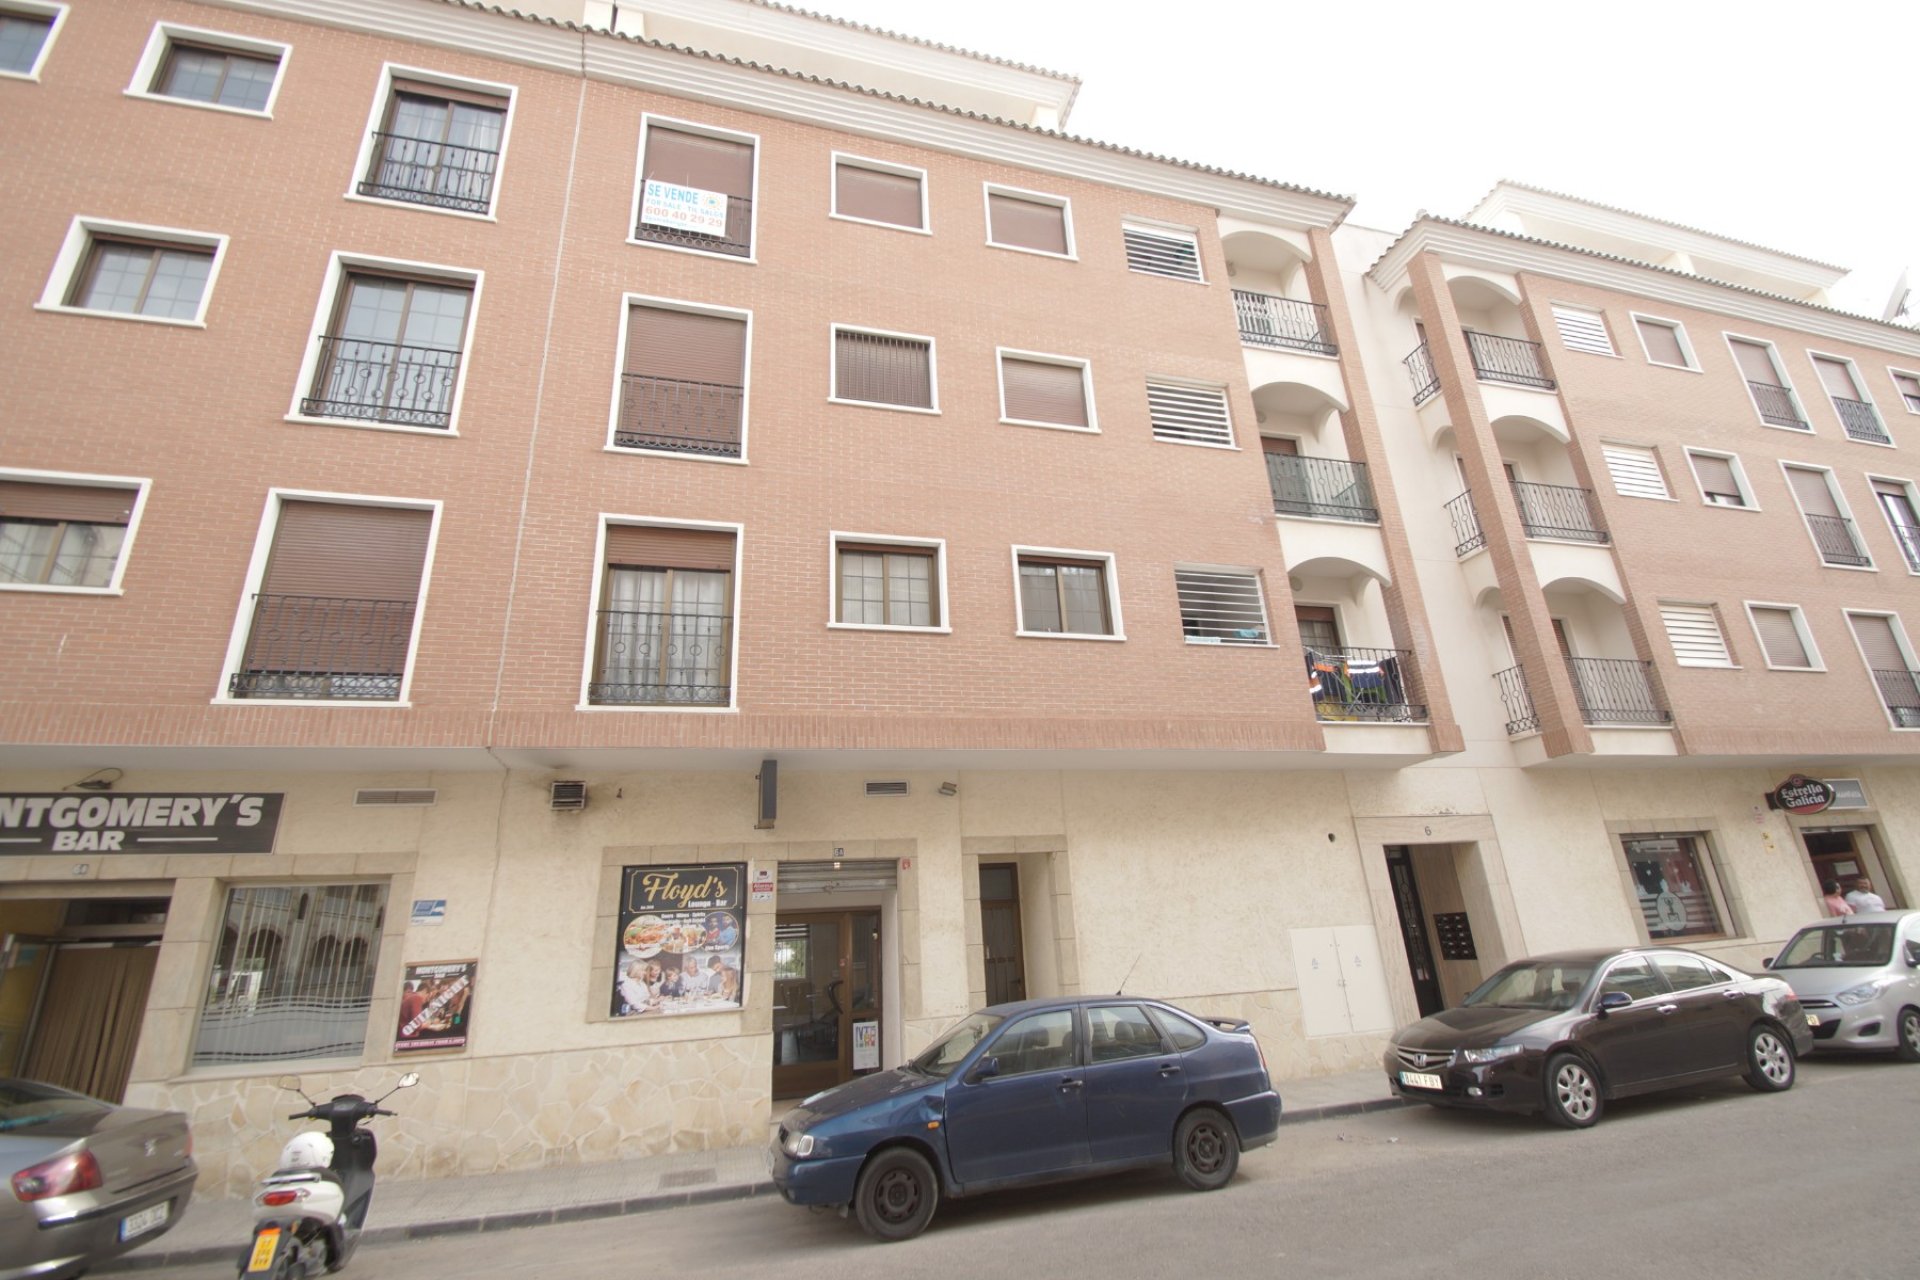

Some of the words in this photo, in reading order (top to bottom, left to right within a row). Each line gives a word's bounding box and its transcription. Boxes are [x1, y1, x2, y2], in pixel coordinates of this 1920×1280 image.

[648, 183, 661, 197] SE
[664, 187, 699, 205] VENDE
[646, 198, 662, 206] FOR
[663, 201, 681, 210] SALE
[645, 205, 669, 218] 600
[672, 211, 687, 221] 40
[690, 214, 705, 224] 29
[708, 217, 723, 227] 29
[1781, 783, 1823, 799] Estrella
[1785, 793, 1825, 808] Galicia
[1424, 825, 1432, 836] 6
[52, 831, 125, 851] BAR
[642, 872, 728, 909] Floyd's
[688, 900, 711, 908] Lounge
[715, 899, 727, 907] Bar
[402, 1007, 432, 1036] QUIZ
